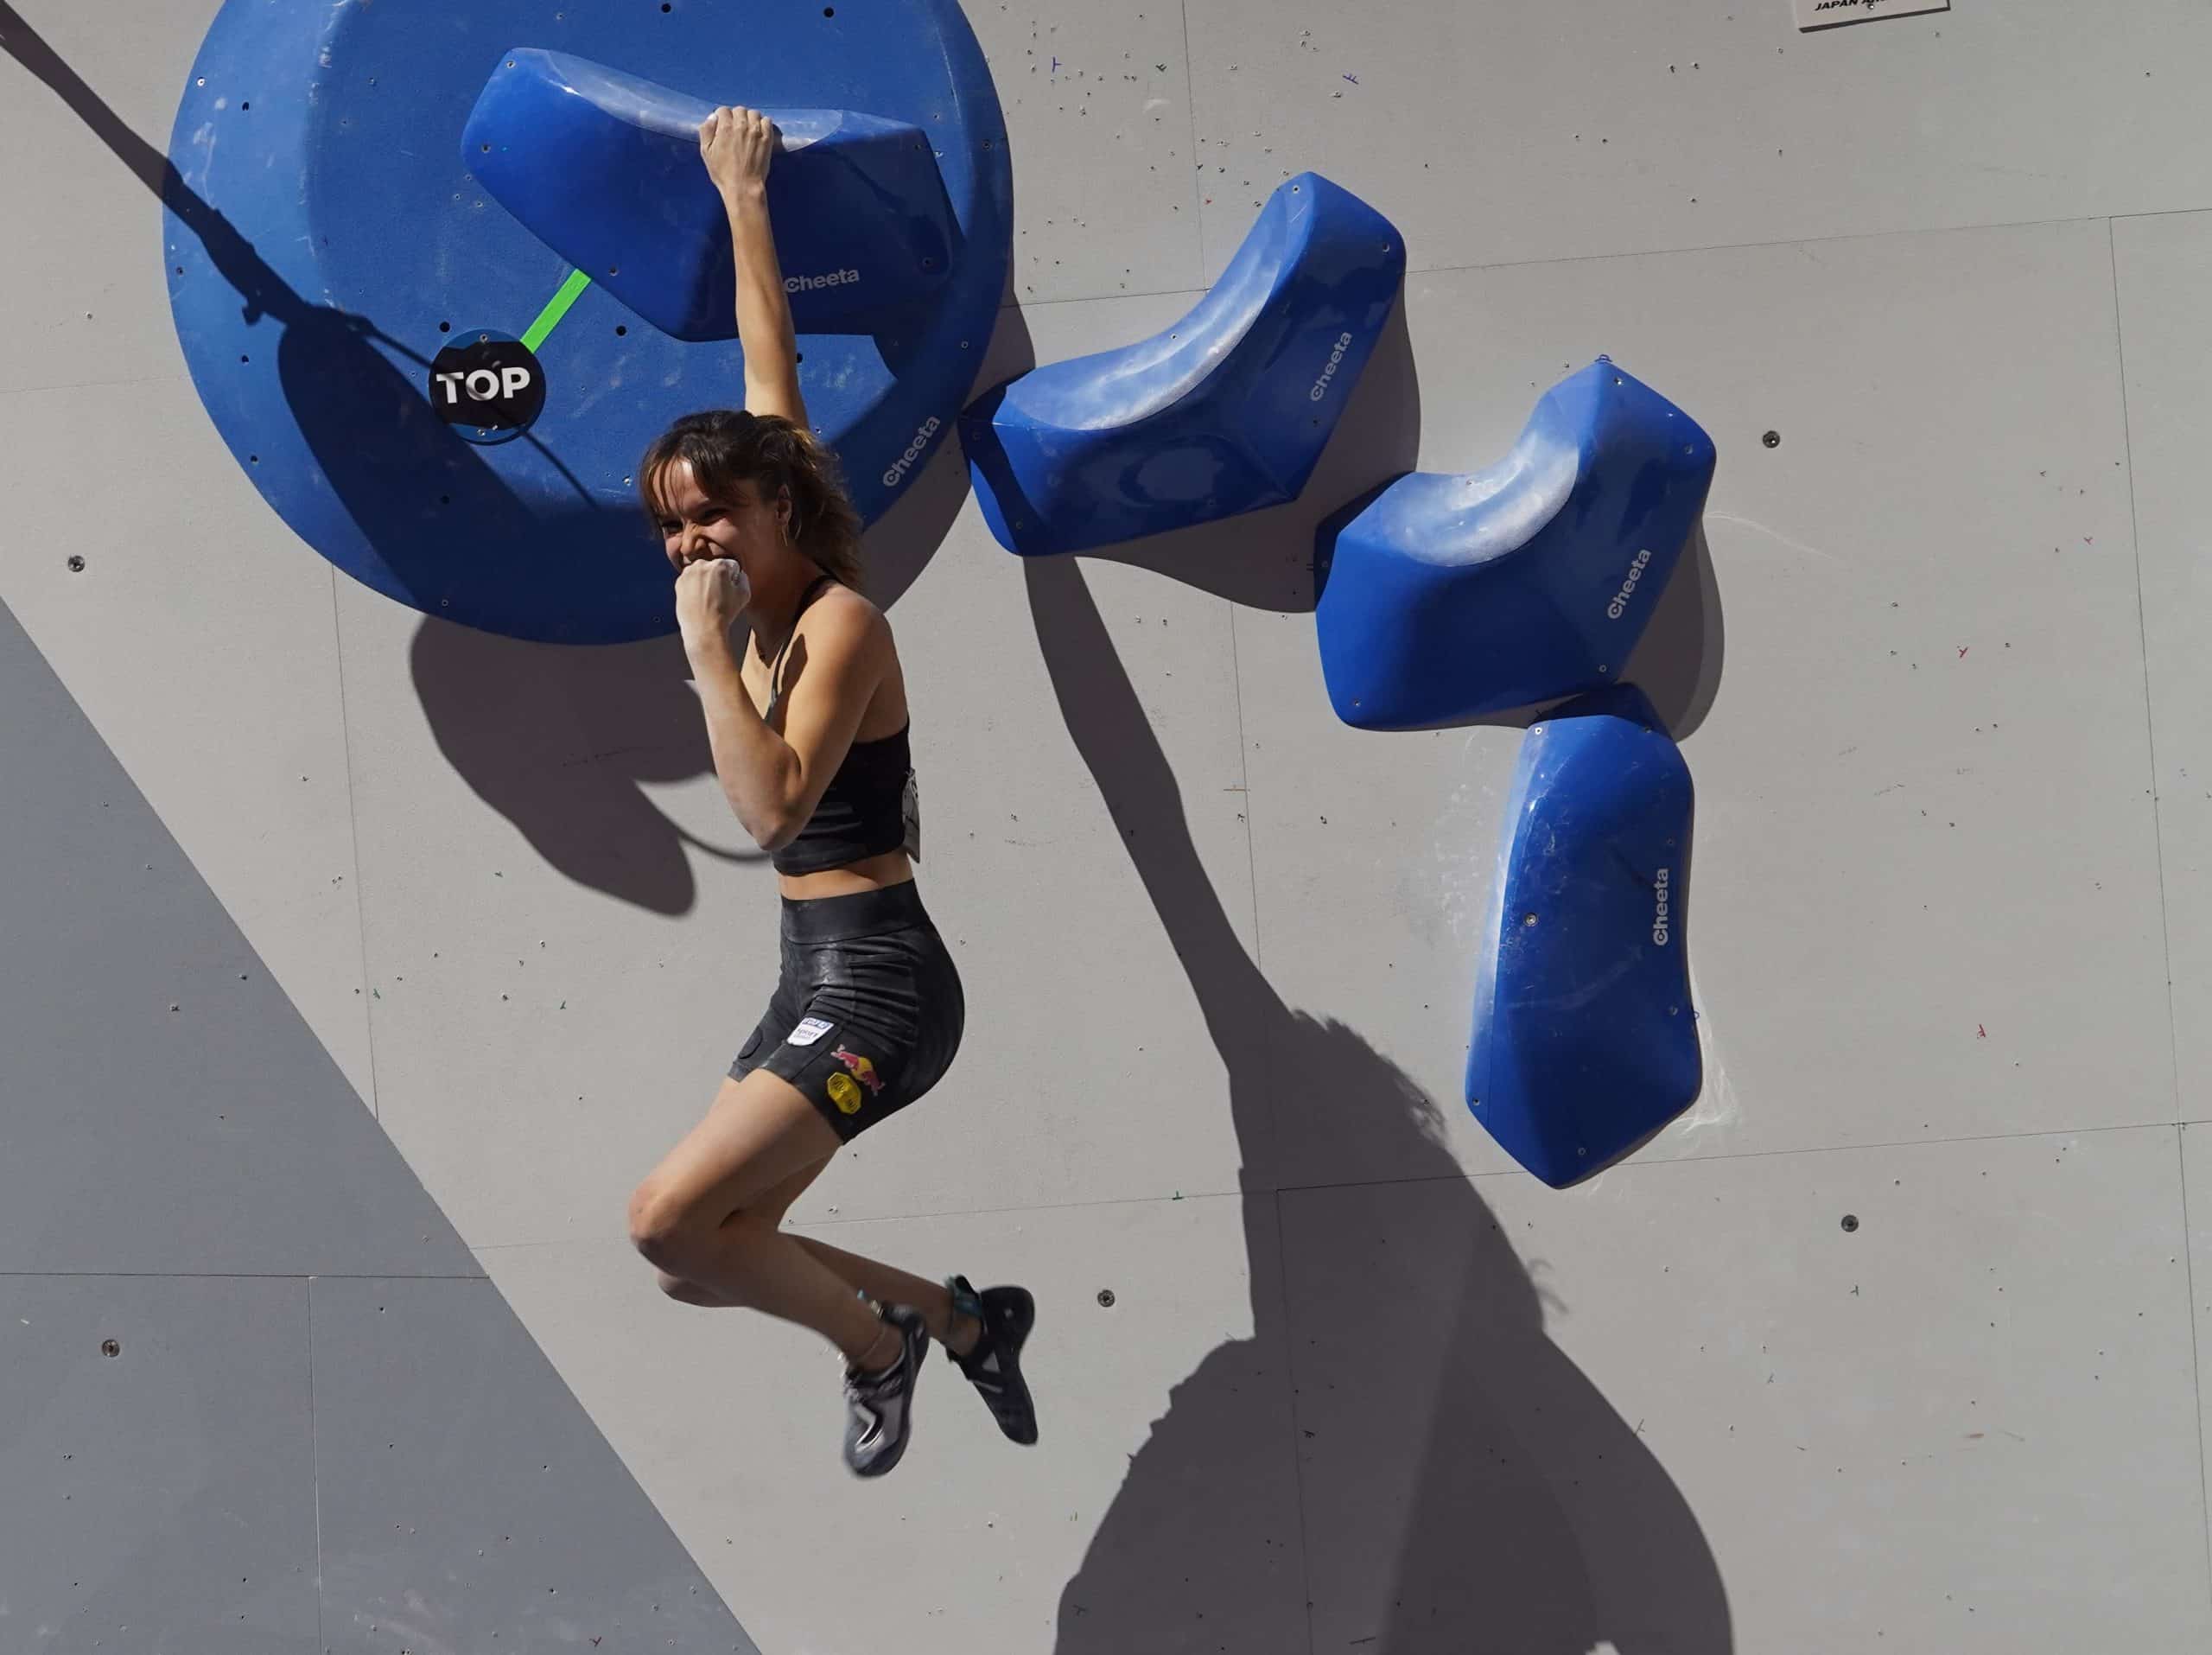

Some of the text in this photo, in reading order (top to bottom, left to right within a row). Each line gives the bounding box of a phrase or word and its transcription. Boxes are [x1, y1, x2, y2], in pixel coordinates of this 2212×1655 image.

[1815, 0, 1858, 10] JAPAN
[784, 269, 861, 293] Cheeta
[435, 367, 531, 404] TOP
[1310, 332, 1353, 402] Cheeta
[882, 417, 941, 487] Cheeta
[1607, 549, 1652, 619] Cheeta
[1653, 868, 1669, 945] Cheeta
